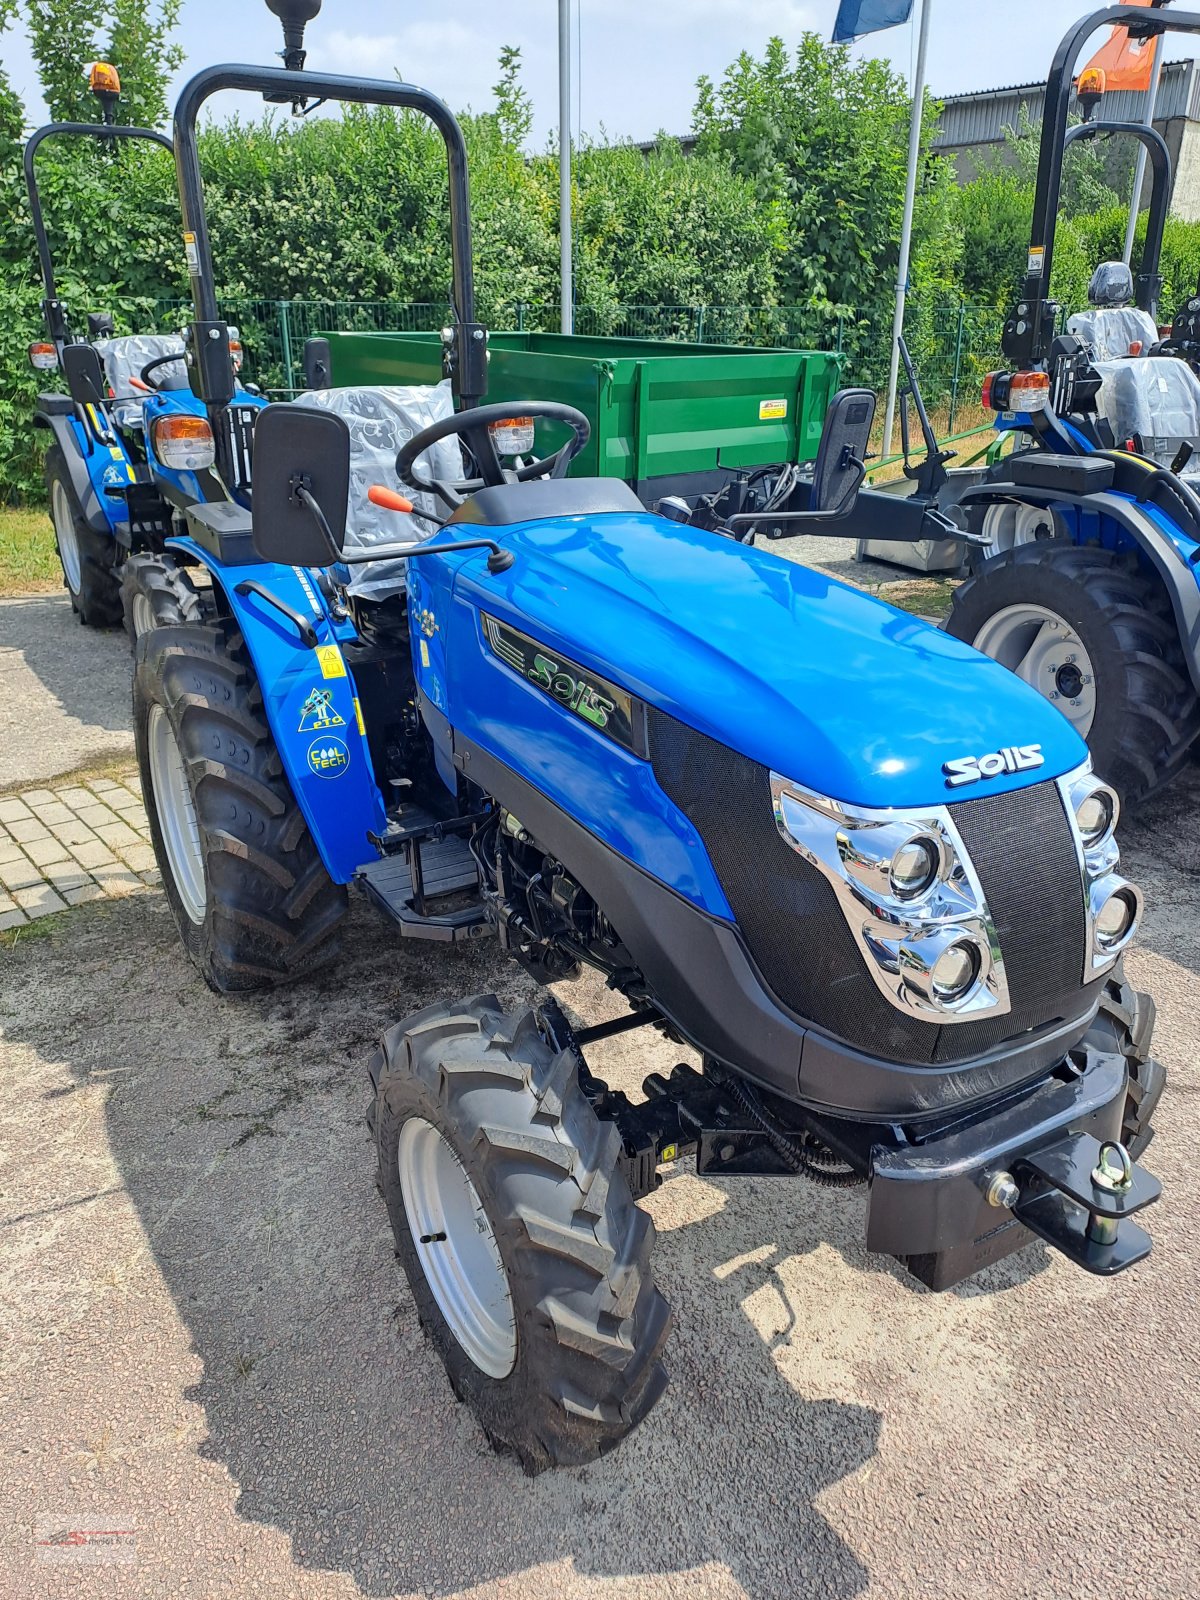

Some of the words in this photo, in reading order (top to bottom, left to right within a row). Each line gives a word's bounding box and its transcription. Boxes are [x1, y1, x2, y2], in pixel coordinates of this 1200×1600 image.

[313, 716, 343, 729] PTO
[311, 747, 344, 760] COOL
[313, 757, 345, 769] TECH
